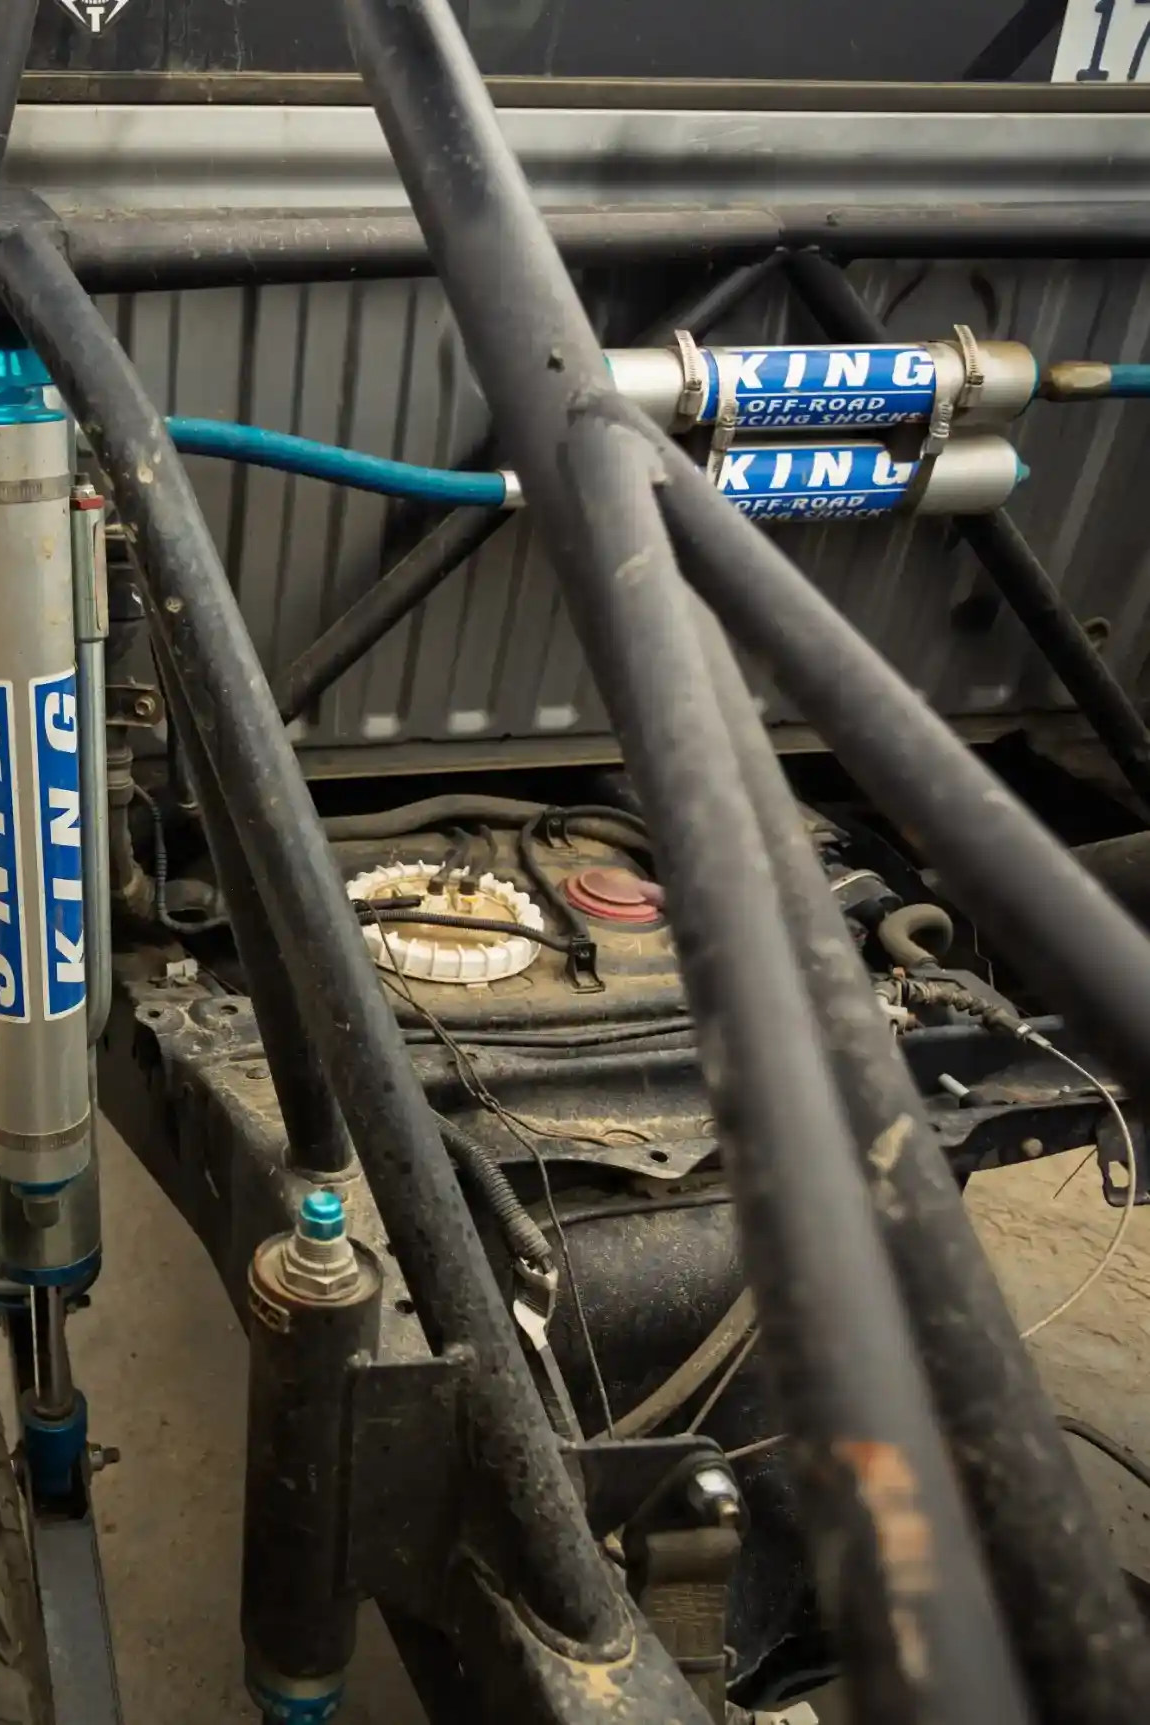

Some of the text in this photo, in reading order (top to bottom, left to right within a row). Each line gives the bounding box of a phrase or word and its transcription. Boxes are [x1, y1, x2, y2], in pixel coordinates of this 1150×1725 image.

[734, 350, 934, 389] KING
[747, 396, 886, 414] OFF-ROAD
[717, 450, 913, 490] KING
[44, 691, 87, 983] KING
